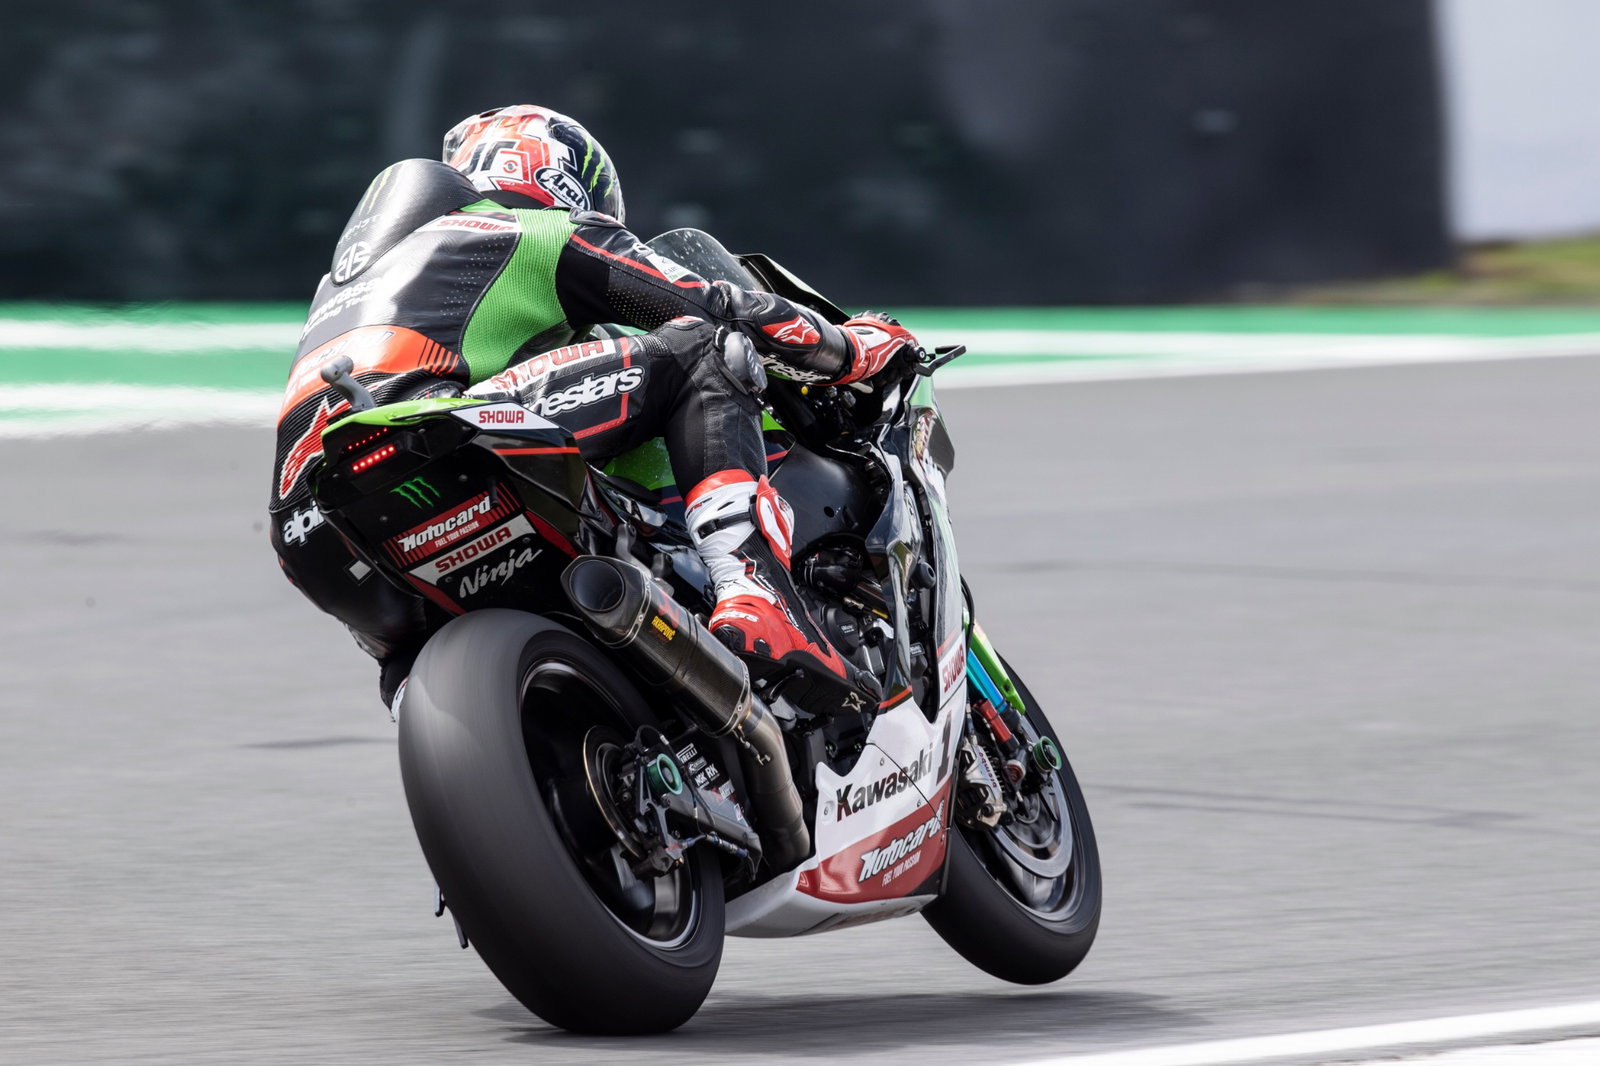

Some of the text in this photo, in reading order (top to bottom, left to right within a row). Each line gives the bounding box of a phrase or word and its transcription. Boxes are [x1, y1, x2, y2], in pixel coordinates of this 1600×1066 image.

[538, 173, 586, 207] Arai
[491, 341, 604, 390] SHOWA
[479, 410, 525, 424] SHOWA
[398, 496, 491, 552] Motocard
[434, 520, 480, 548] FUEL YOUR PASSION
[435, 526, 512, 573] SHOWA
[459, 547, 543, 598] Ninja
[941, 643, 965, 693] SHOWA
[676, 743, 698, 764] PIRELLI
[705, 763, 719, 779] RK
[936, 710, 953, 787] 1
[836, 742, 933, 822] Kawasaki
[858, 799, 945, 882] Motocard
